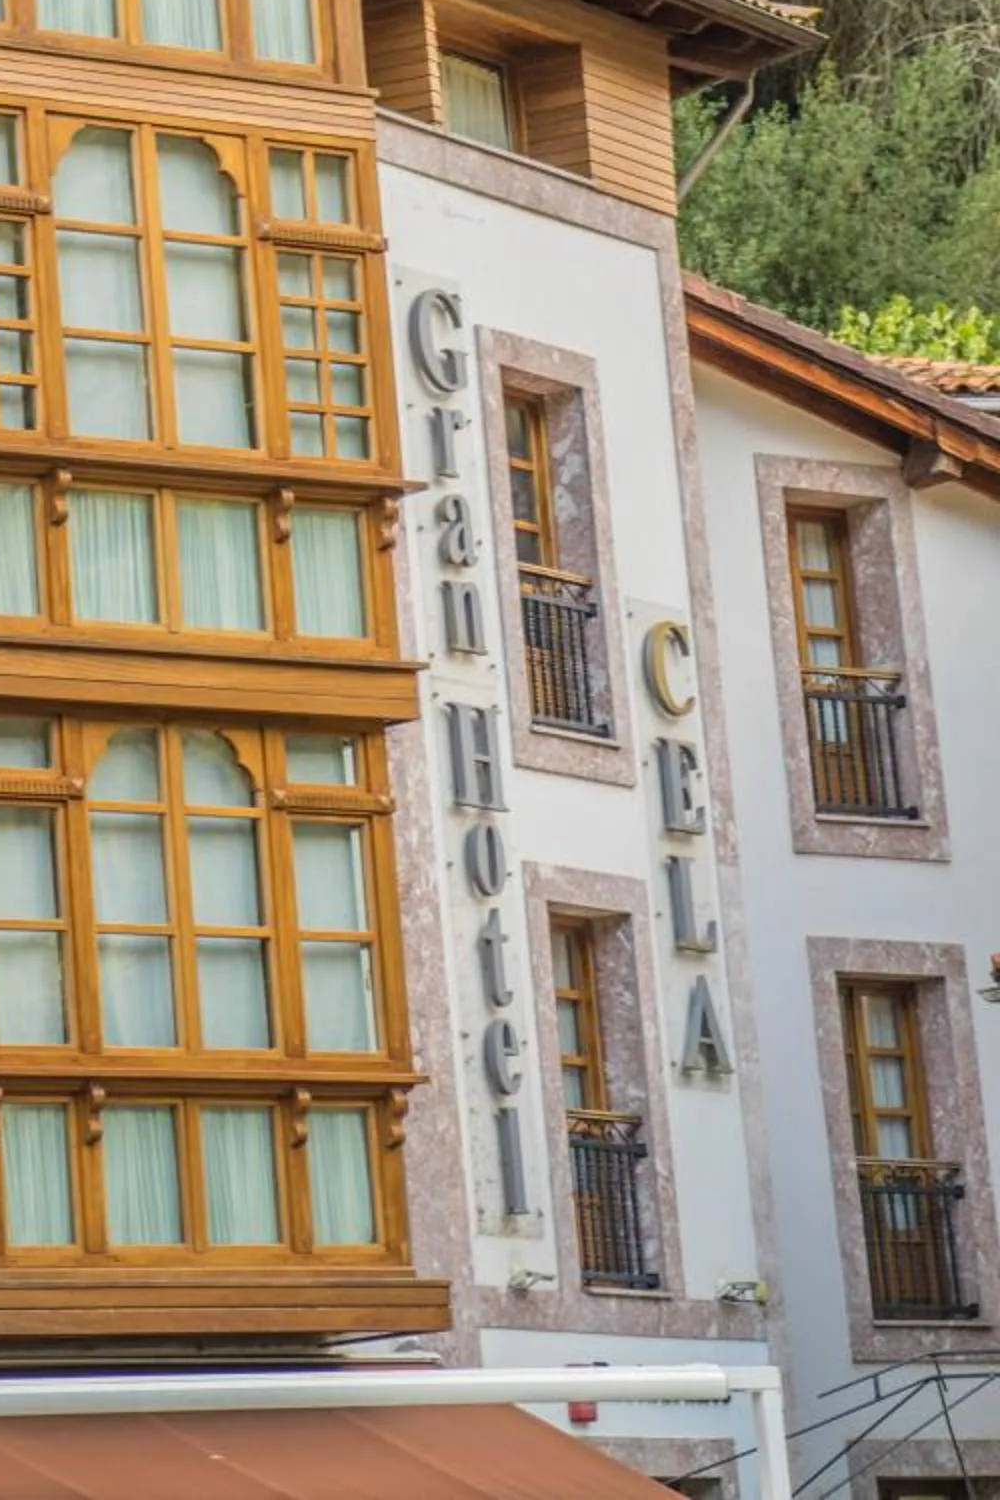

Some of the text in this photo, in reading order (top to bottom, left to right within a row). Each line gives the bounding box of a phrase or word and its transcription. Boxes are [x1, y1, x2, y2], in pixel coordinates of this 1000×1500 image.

[409, 288, 529, 1214] Gran Hotel
[642, 620, 734, 1075] CELA
